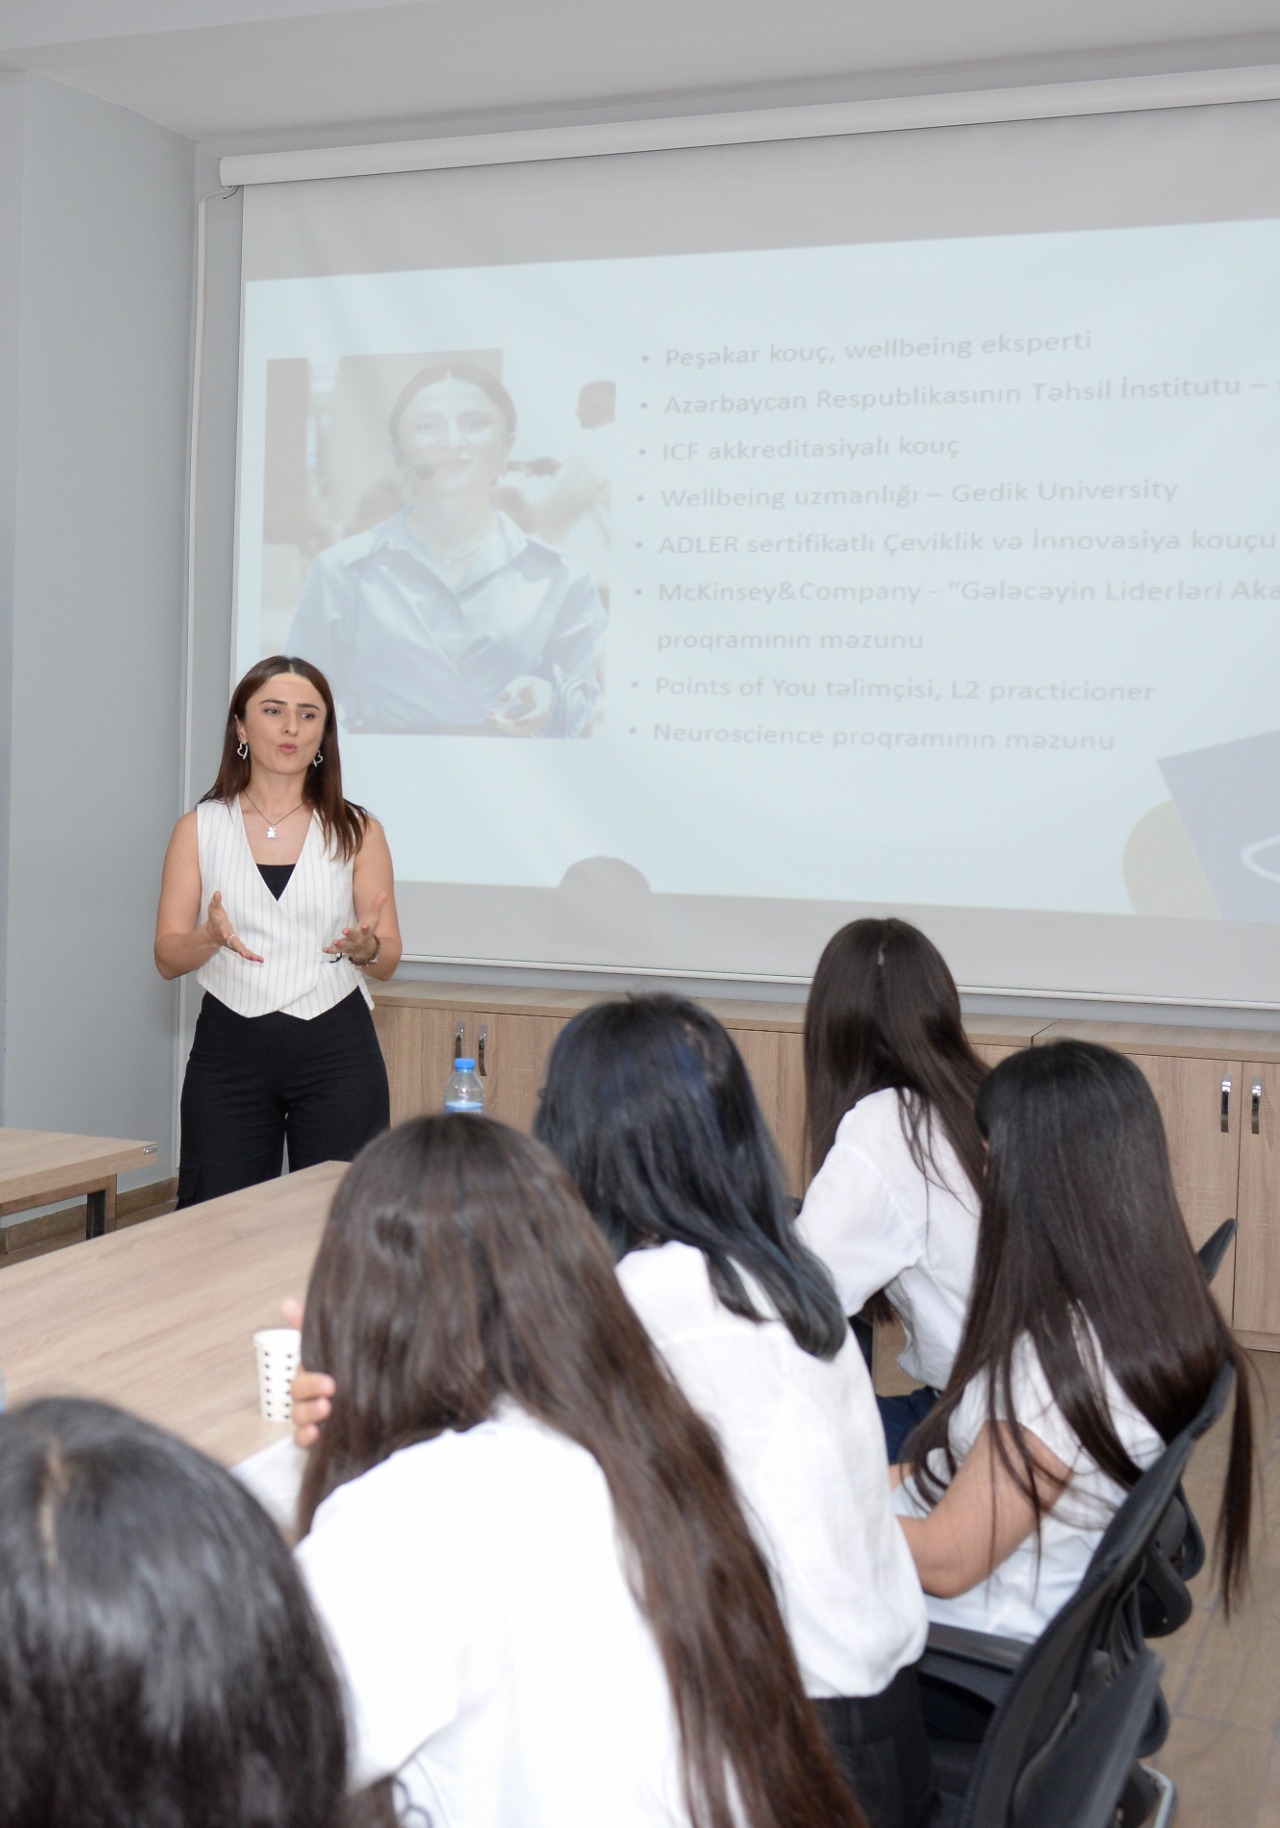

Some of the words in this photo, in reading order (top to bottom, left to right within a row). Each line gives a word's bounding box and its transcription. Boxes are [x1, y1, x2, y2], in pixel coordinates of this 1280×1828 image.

[666, 346, 760, 369] Peşəkar
[770, 344, 834, 364] kouç,
[845, 337, 972, 359] wellbeing
[982, 330, 1091, 356] eksperti
[664, 394, 806, 415] Azərbaycan
[818, 386, 1021, 411] Respublikasının
[1032, 380, 1111, 401] Təhsil
[1122, 376, 1240, 398] İnstitutu
[663, 443, 698, 461] ICF
[708, 437, 889, 460] akkreditasiyalı
[899, 436, 959, 458] kouç
[661, 488, 785, 510] Wellbeing
[795, 485, 918, 507] uzmanlığı
[952, 482, 1027, 502] Gedik
[1039, 479, 1178, 502] University
[659, 536, 738, 553] ADLER
[748, 533, 873, 553] sertifikatlı
[884, 532, 983, 556] Çeviklik
[993, 536, 1022, 550] və
[1033, 528, 1180, 553] İnnovasiya
[1192, 530, 1275, 553] kouçu
[659, 581, 921, 604] McKinsey&Company
[1107, 581, 1221, 600] Liderləri
[658, 635, 810, 652] proqramının
[820, 635, 923, 648] məzunu
[656, 677, 730, 695] Points
[739, 677, 764, 696] of
[772, 679, 816, 697] You
[826, 679, 941, 702] təlimçisi,
[952, 681, 979, 699] L2
[990, 681, 1154, 702] practicioner
[654, 724, 823, 744] Neuroscience
[833, 732, 995, 749] proqramının
[1006, 735, 1113, 749] məzunu
